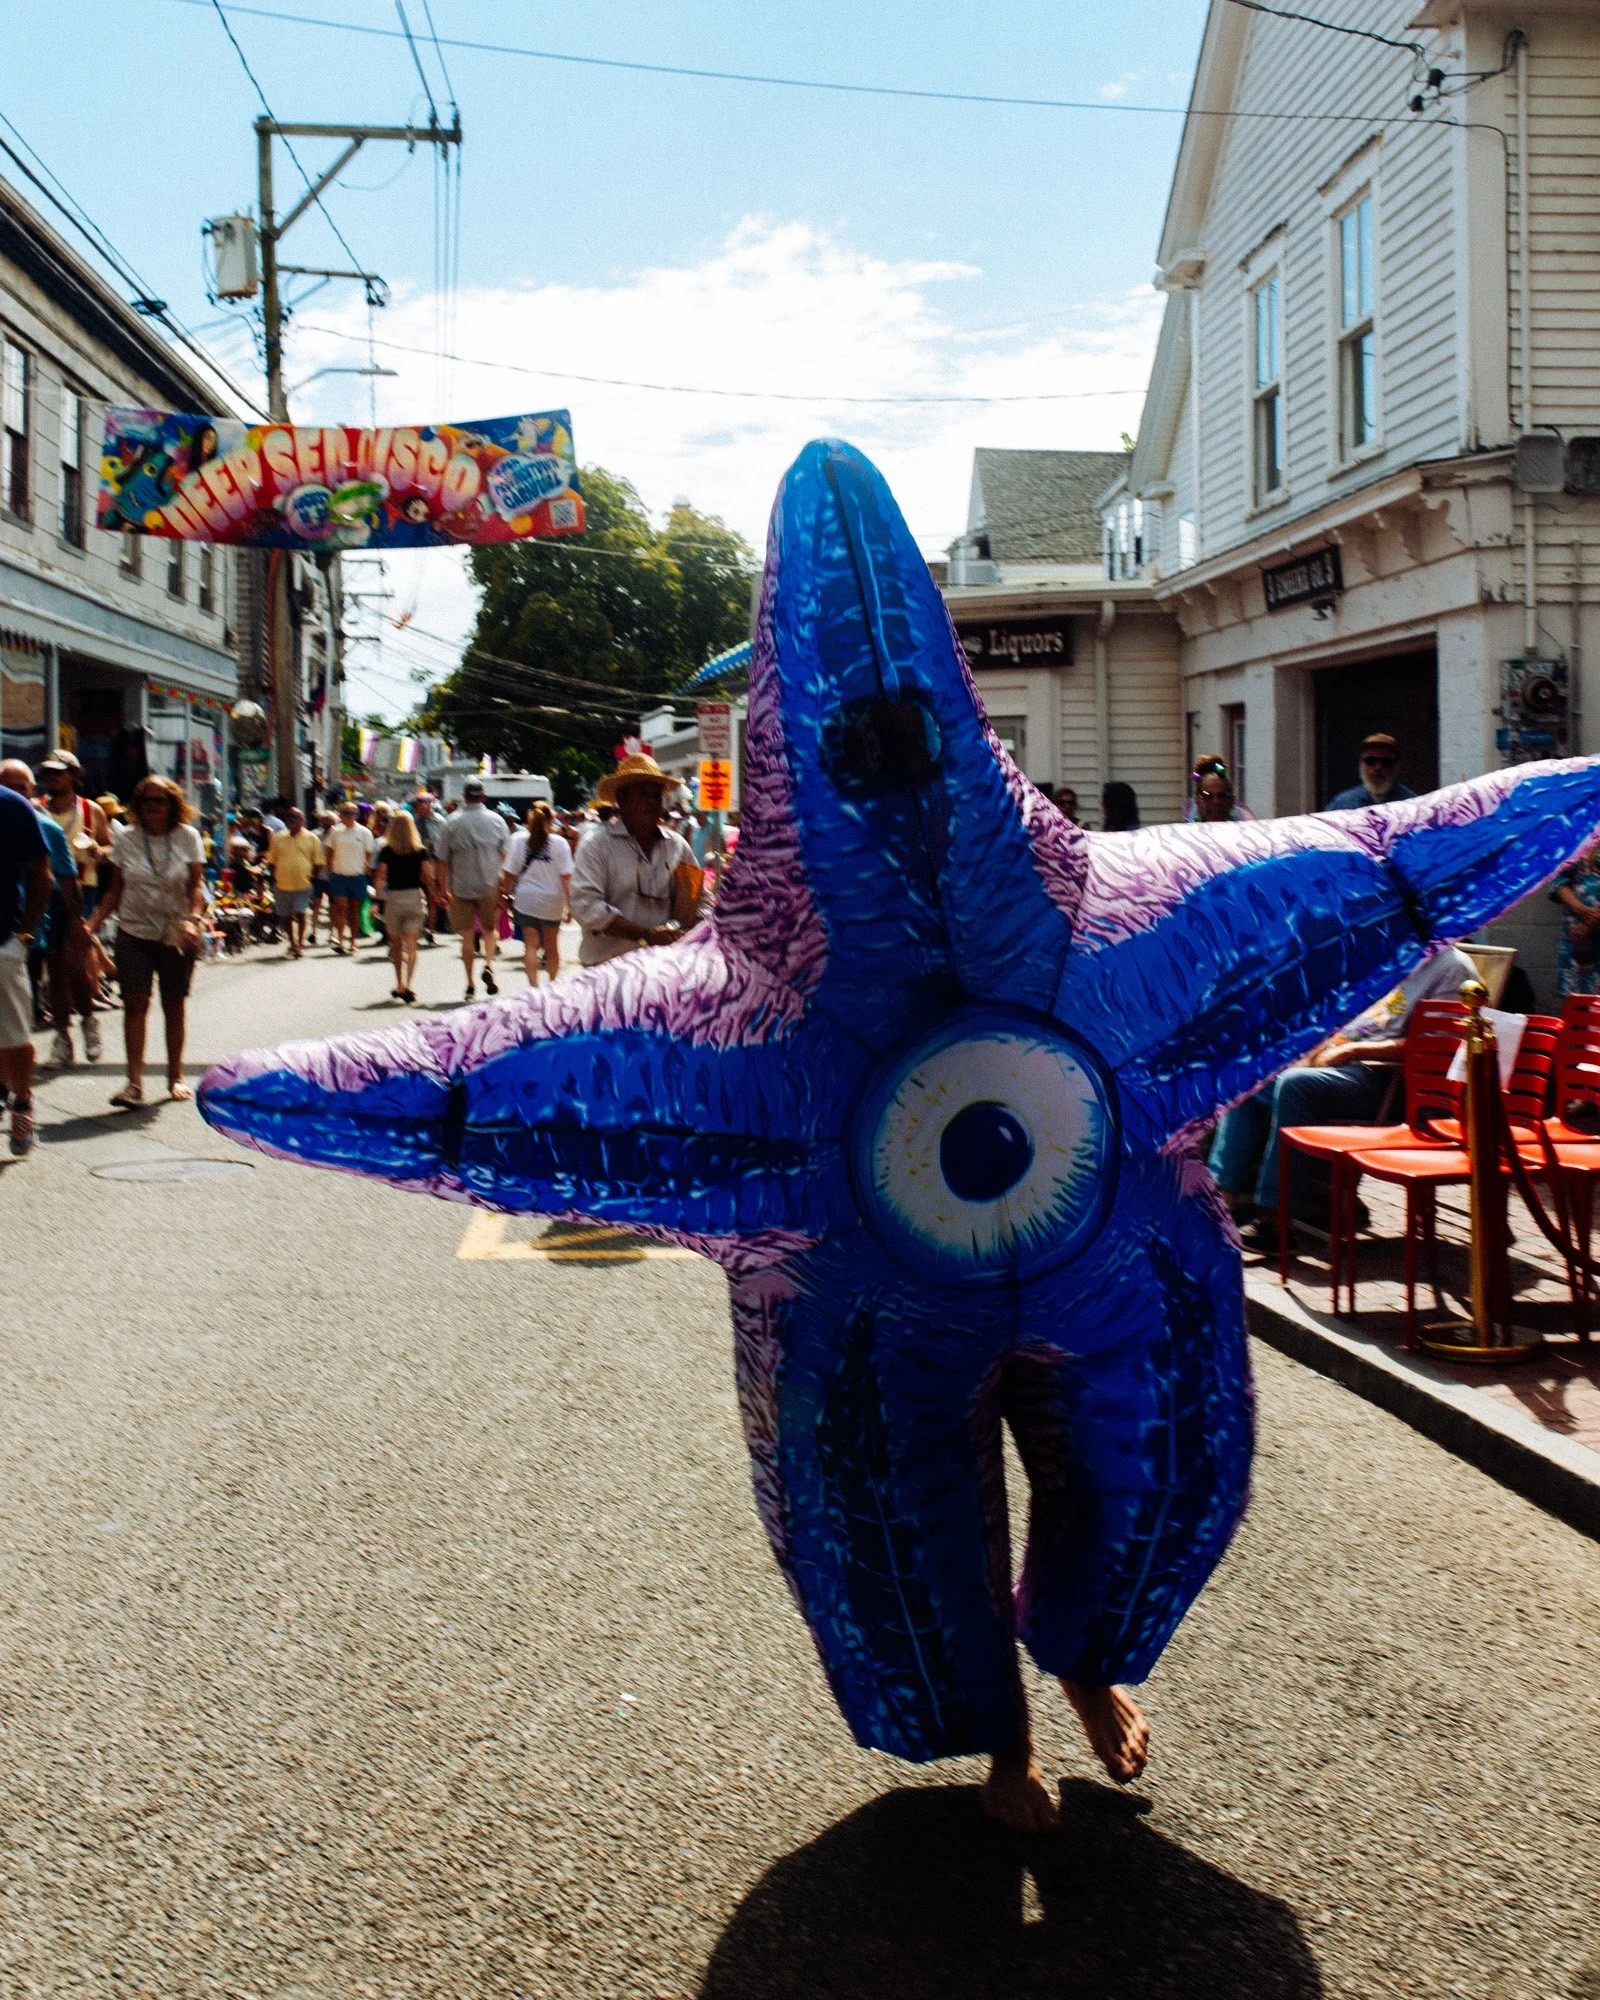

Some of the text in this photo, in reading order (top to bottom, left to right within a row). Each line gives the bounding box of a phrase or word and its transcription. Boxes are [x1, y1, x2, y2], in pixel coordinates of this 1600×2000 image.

[160, 447, 264, 540] DEEP
[263, 427, 350, 494] SEA
[357, 427, 481, 512] DISCO
[988, 629, 1064, 664] Liquors
